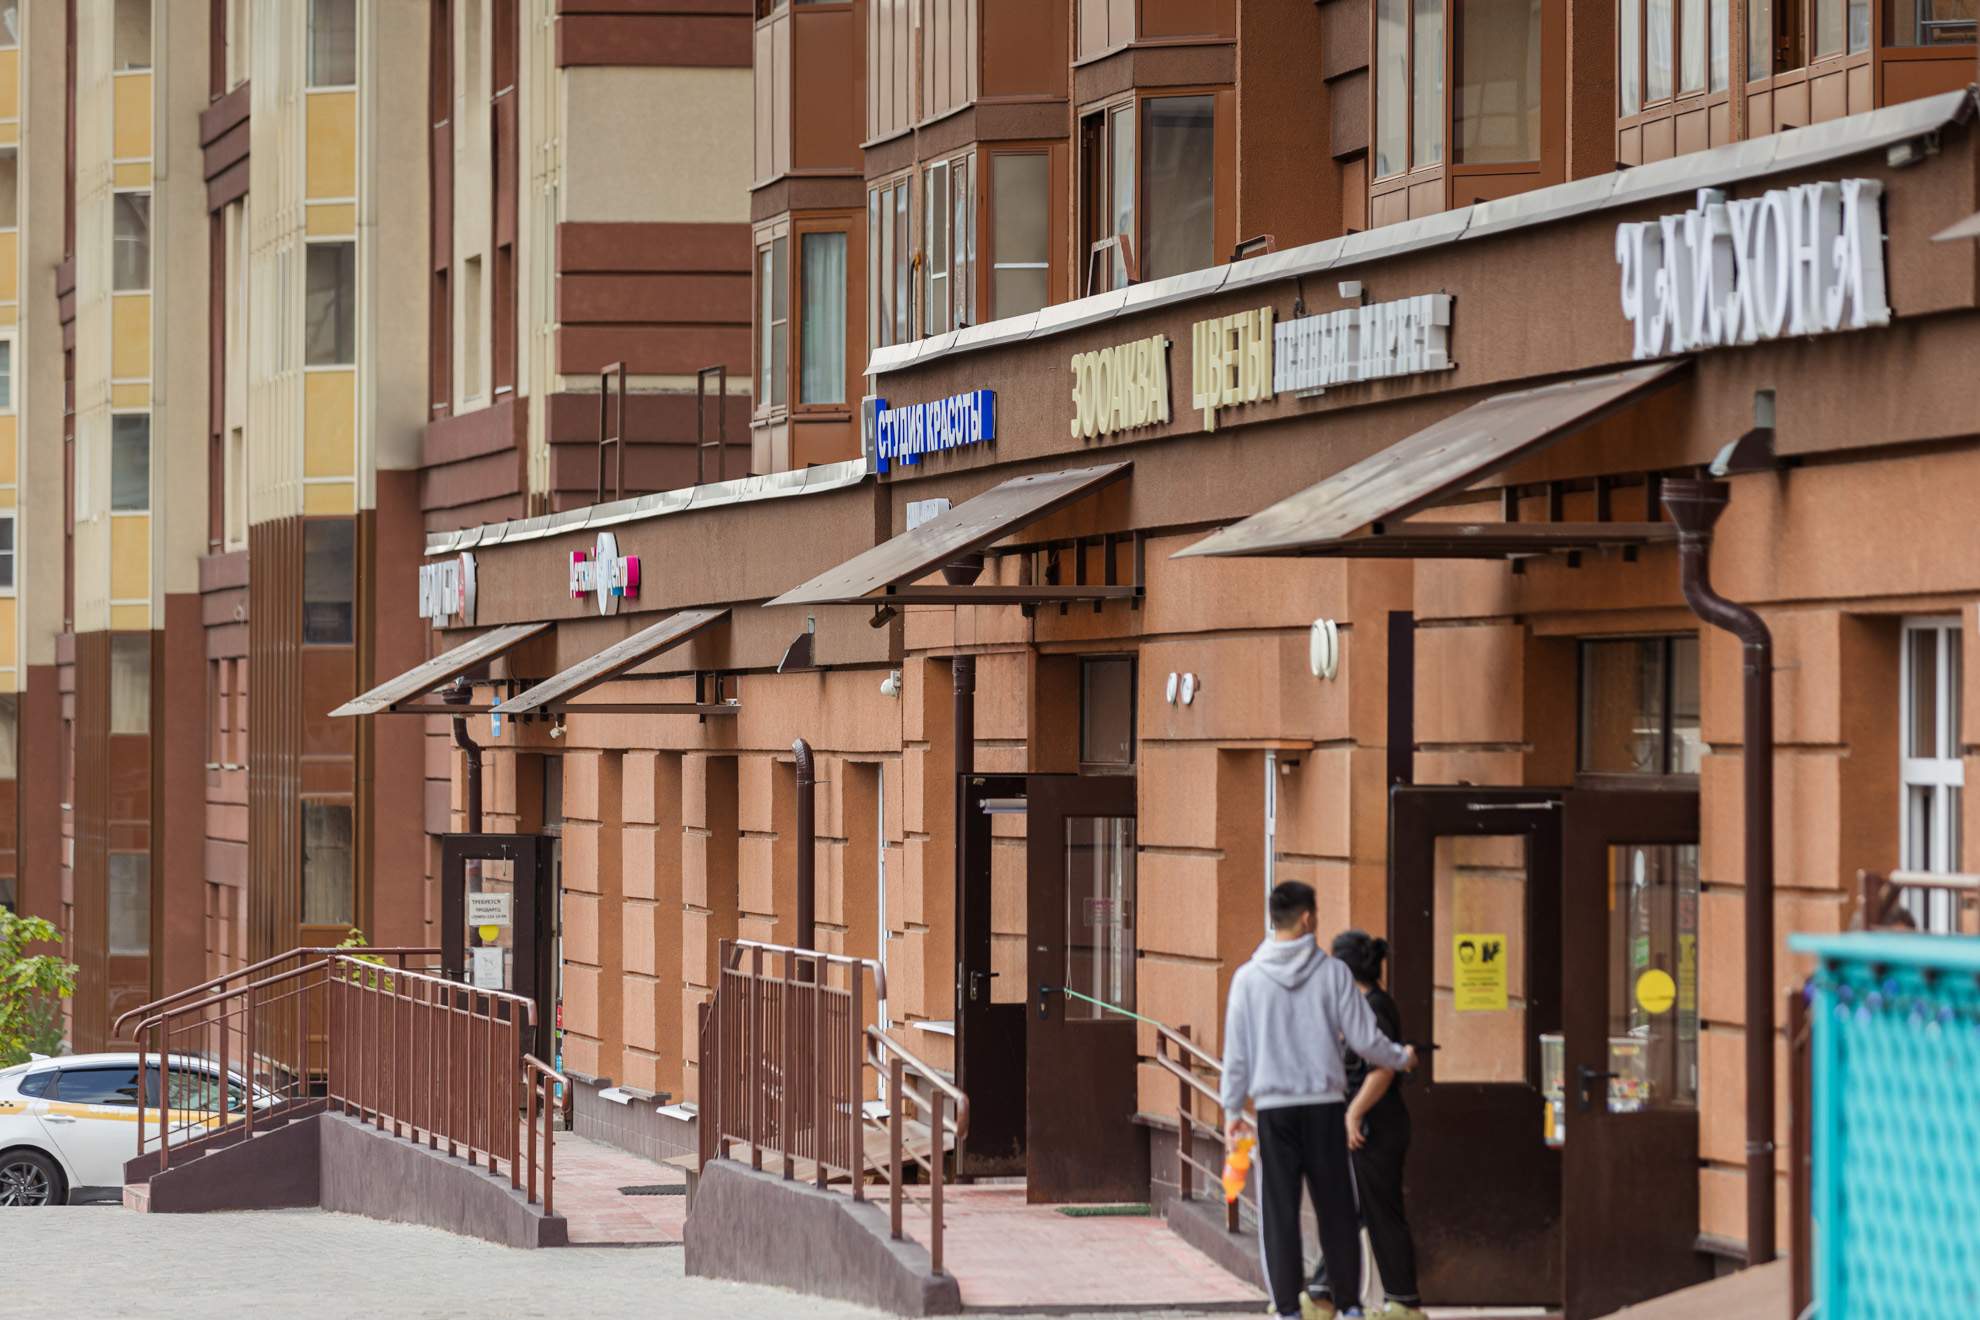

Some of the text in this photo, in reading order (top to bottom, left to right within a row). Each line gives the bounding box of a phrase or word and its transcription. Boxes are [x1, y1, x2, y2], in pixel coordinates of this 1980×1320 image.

[1616, 178, 1888, 360] ЧАЙХОНА
[1071, 334, 1170, 439] ЗООАКВА
[1193, 306, 1273, 432] ЦВЕТЫ
[877, 404, 924, 466] СТУДИЯ
[926, 390, 982, 452] КРАСОТЫ
